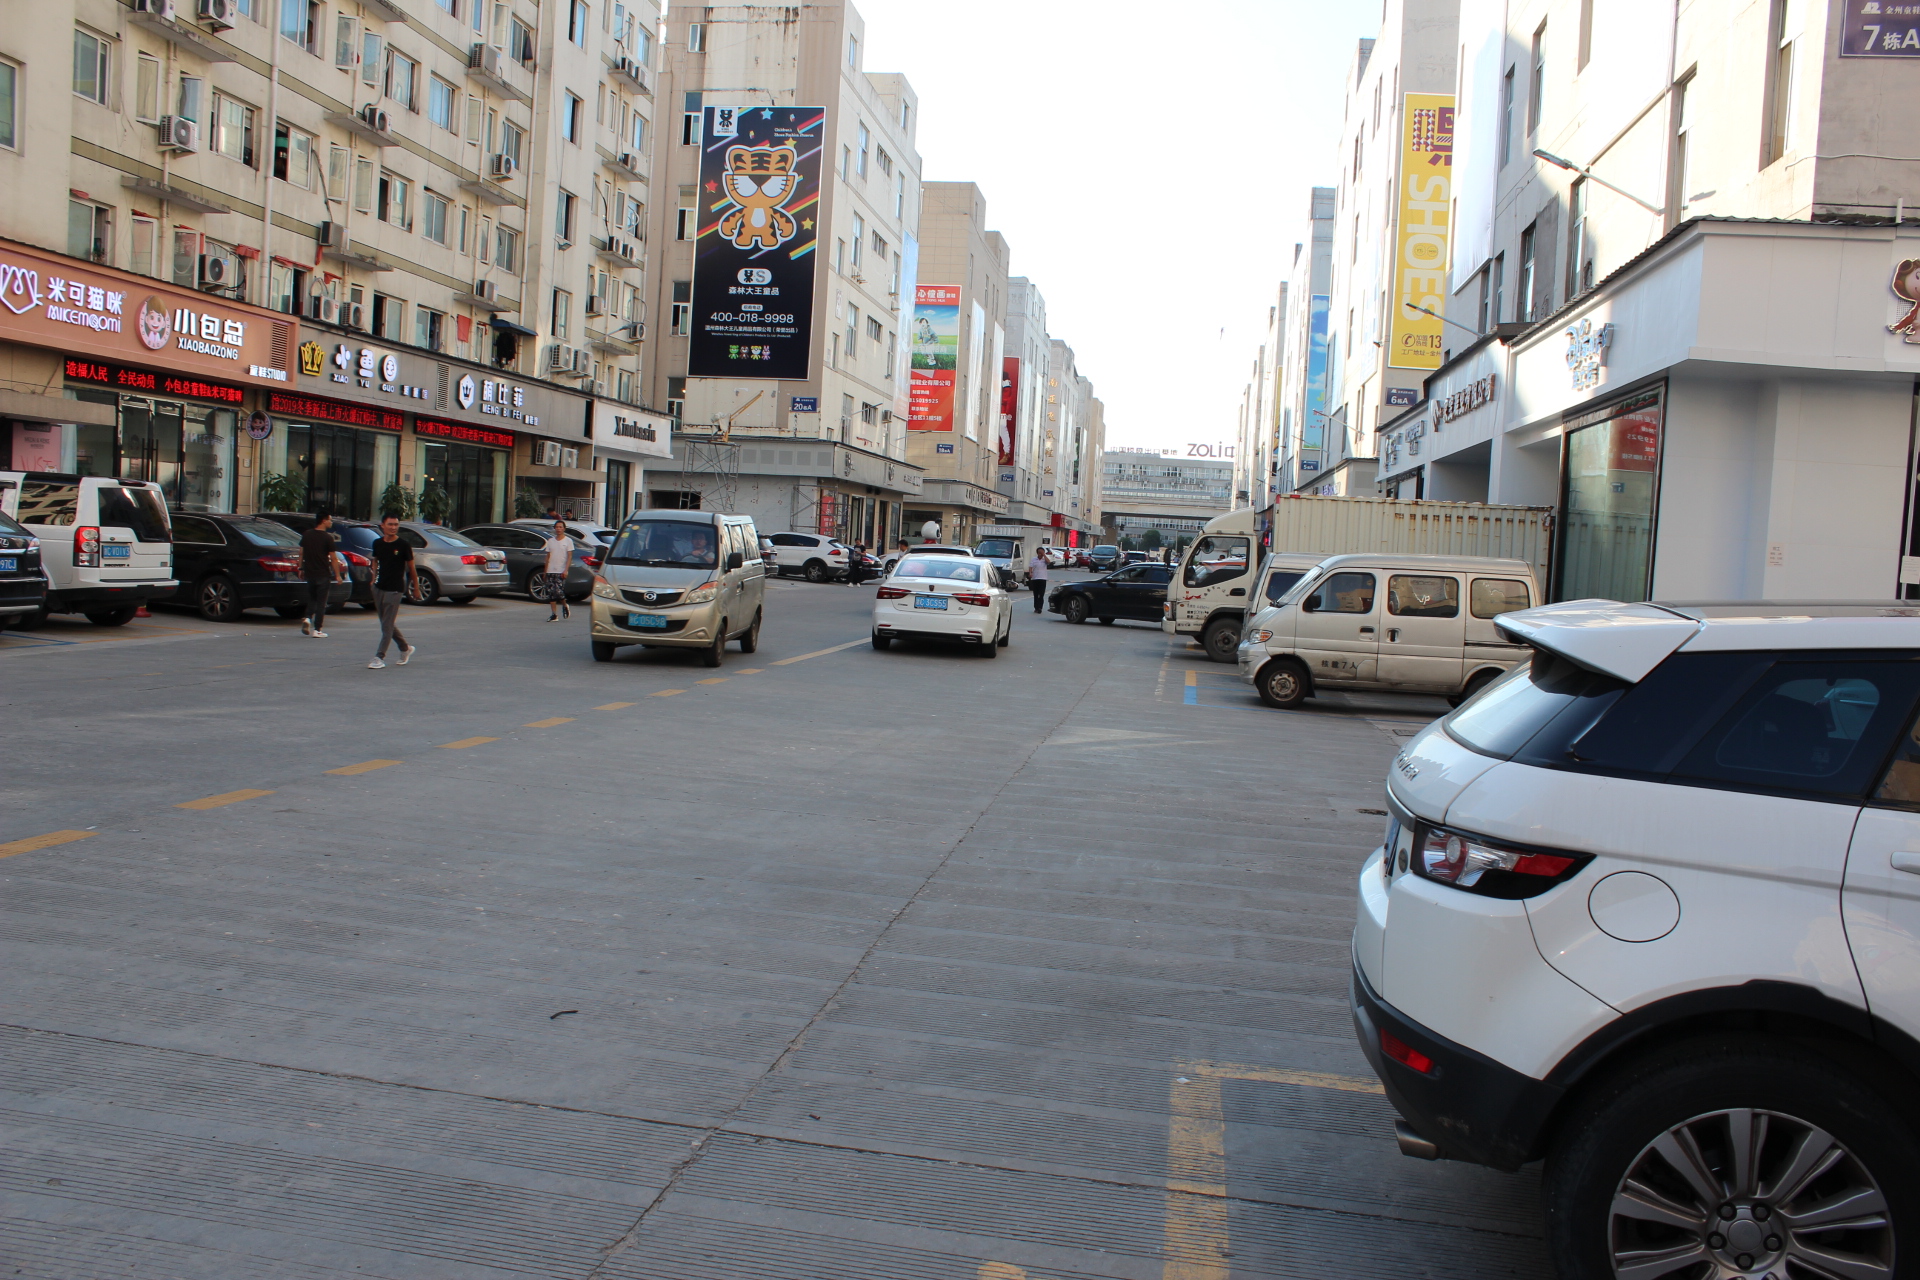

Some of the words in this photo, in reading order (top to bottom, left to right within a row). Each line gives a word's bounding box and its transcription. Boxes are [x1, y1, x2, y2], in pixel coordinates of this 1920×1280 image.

[1862, 25, 1920, 51] 7栋A
[1401, 174, 1450, 321] SHOES
[47, 277, 122, 315] 米可猫咪
[728, 286, 780, 296] 森林大王童品
[915, 289, 946, 299] 心僮画
[173, 308, 244, 347] 小包总
[710, 311, 794, 324] 400-018-9998
[177, 336, 239, 360] XIAOBAOZONG
[66, 360, 109, 382] 造福人民
[117, 370, 155, 389] 全民动员
[164, 378, 243, 402] 小包总童鞋&米可猫咪
[333, 373, 349, 384] XIAO
[360, 379, 370, 388] YU
[382, 384, 395, 393] GUO
[482, 379, 524, 408] 萌比菲
[482, 403, 499, 415] MENG
[512, 409, 522, 420] FEI
